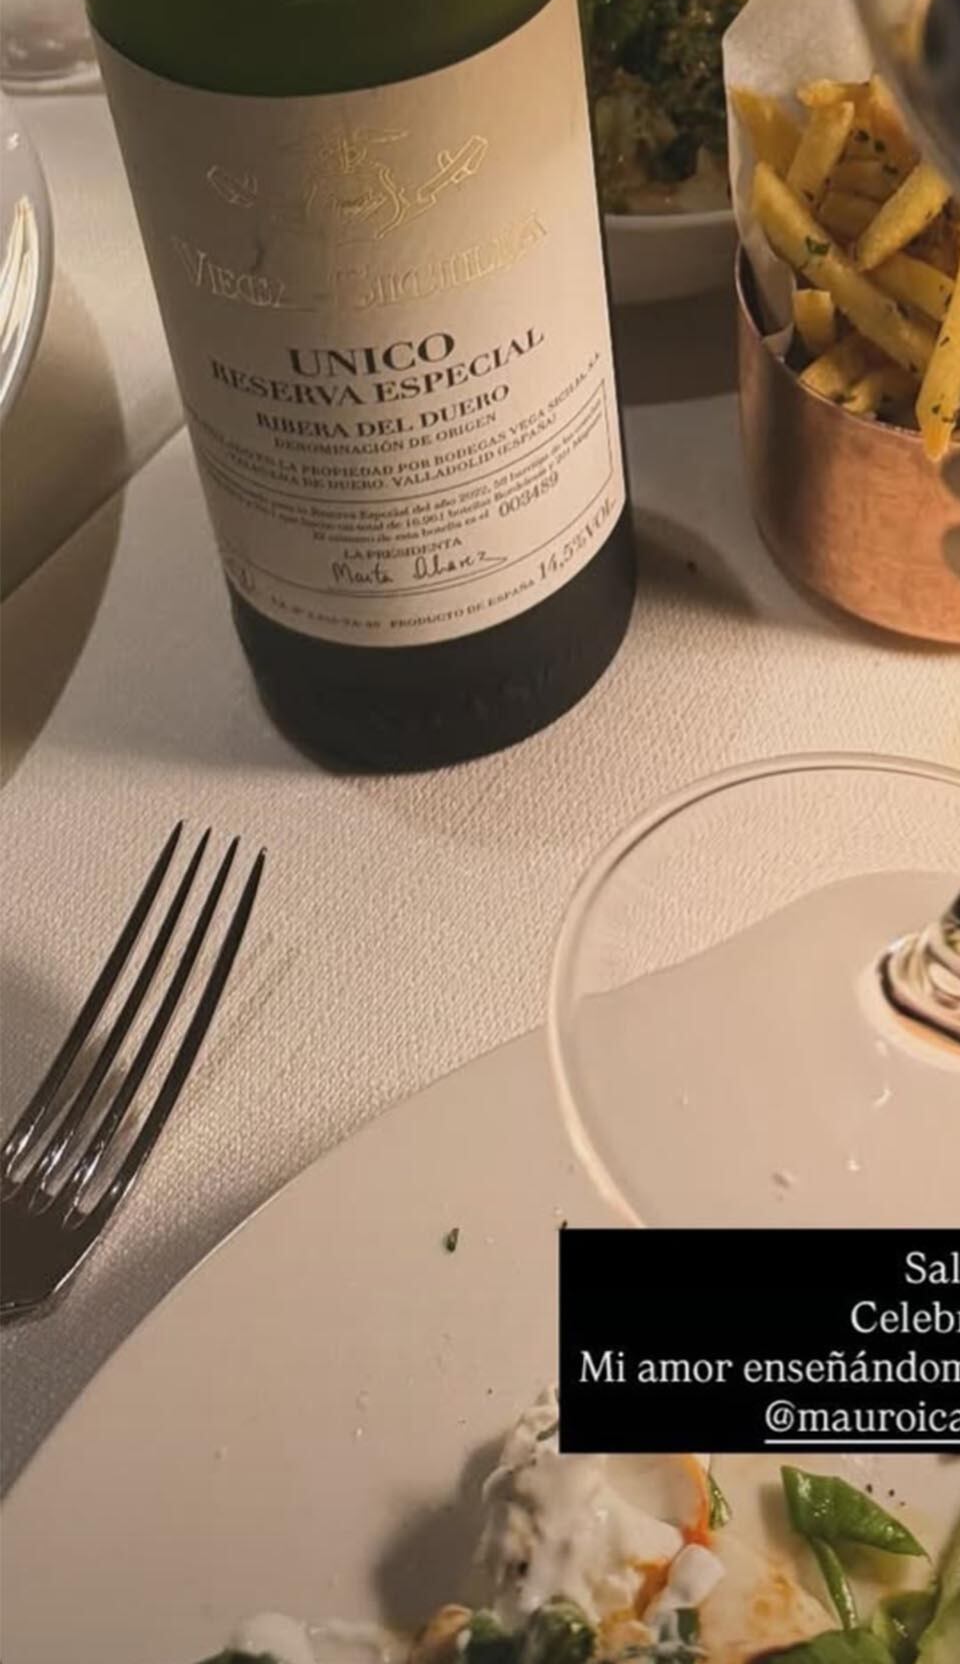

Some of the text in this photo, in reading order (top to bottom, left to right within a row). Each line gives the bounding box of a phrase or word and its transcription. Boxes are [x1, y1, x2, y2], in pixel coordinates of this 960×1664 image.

[208, 327, 545, 406] RESERVA ESPECIAL
[287, 332, 455, 378] UNICO
[256, 411, 350, 438] RIBERA
[356, 417, 414, 437] DEL
[420, 383, 510, 429] DUERO
[273, 412, 497, 456] DENOMINACIÓN DE ORIGEN
[301, 465, 393, 479] PROPIEDAD
[397, 457, 431, 474] POR
[434, 431, 507, 469] BODEGAS
[509, 408, 545, 435] VEGA
[391, 450, 494, 487] VALLADOLID
[498, 412, 557, 456] (ESPAÑA)
[498, 470, 559, 518] 003489
[344, 536, 464, 561] LA PRESIDENTA
[390, 608, 465, 628] PRODUCTO
[467, 602, 486, 615] DE
[488, 579, 536, 607] ESPAÑA
